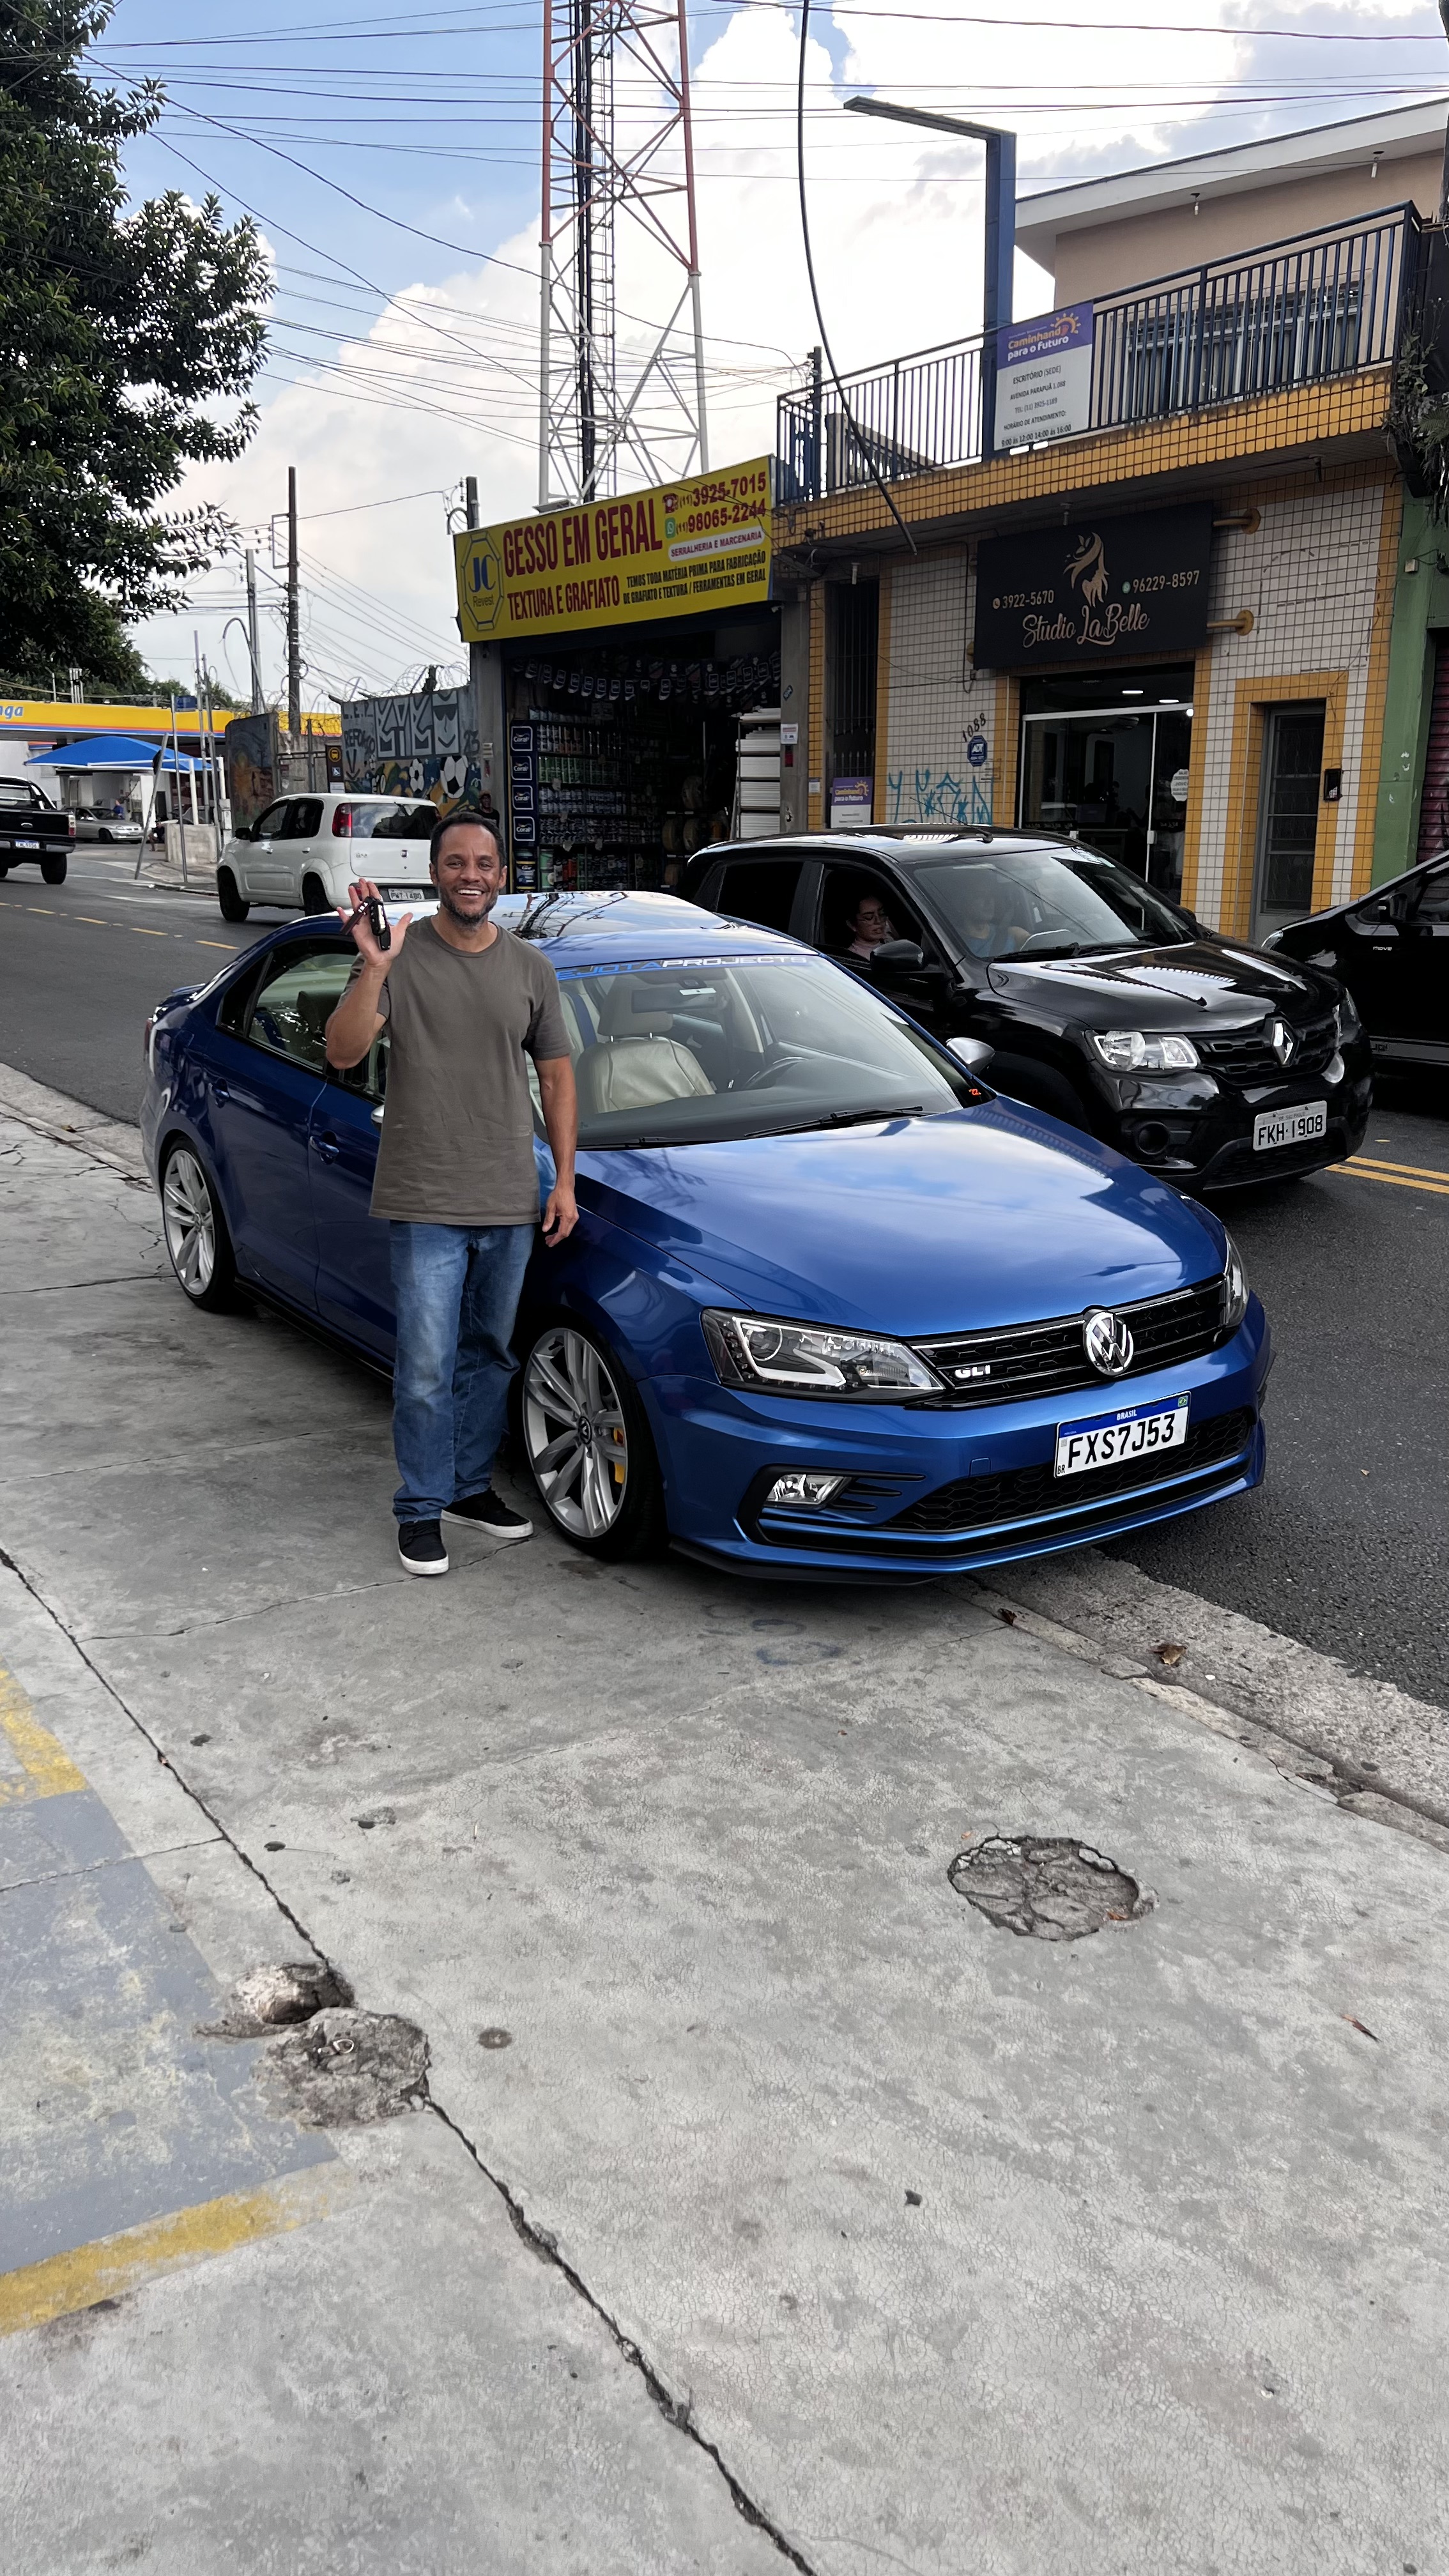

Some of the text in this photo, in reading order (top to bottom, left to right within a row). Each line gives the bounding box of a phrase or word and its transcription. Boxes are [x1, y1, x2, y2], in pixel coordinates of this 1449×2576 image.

[1008, 348, 1028, 362] para
[1038, 336, 1069, 351] futuro
[1013, 365, 1061, 384] ESCRITÓRIO (SEDE)
[1010, 390, 1029, 400] AVENIDA
[503, 498, 663, 578] GESSO EM GERAL
[671, 532, 762, 557] SERRALHERIA E MARCENARIA
[627, 549, 765, 588] TEMOS TODA MATÉRIA PRIMA PARA FABRICAÇÃO
[623, 593, 630, 604] DE
[631, 588, 657, 603] GRAFIATO
[659, 588, 662, 599] E
[663, 583, 688, 599] TEXTURA
[693, 574, 735, 594] FERRAMENTAS
[736, 572, 745, 585] EM
[747, 569, 766, 584] GERAL
[1133, 571, 1200, 594] 96229-8597
[507, 575, 620, 620] TEXTURA E GRAFIATO
[1002, 590, 1054, 608] 3922-5670
[1022, 613, 1076, 648] Studio
[0, 705, 24, 719] ga
[962, 712, 986, 742] 1088
[972, 743, 984, 753] ADT
[954, 1365, 991, 1378] GLI
[1116, 1409, 1137, 1421] BRASIL
[1068, 1413, 1175, 1468] FXS7J53
[1057, 1464, 1065, 1475] BR
